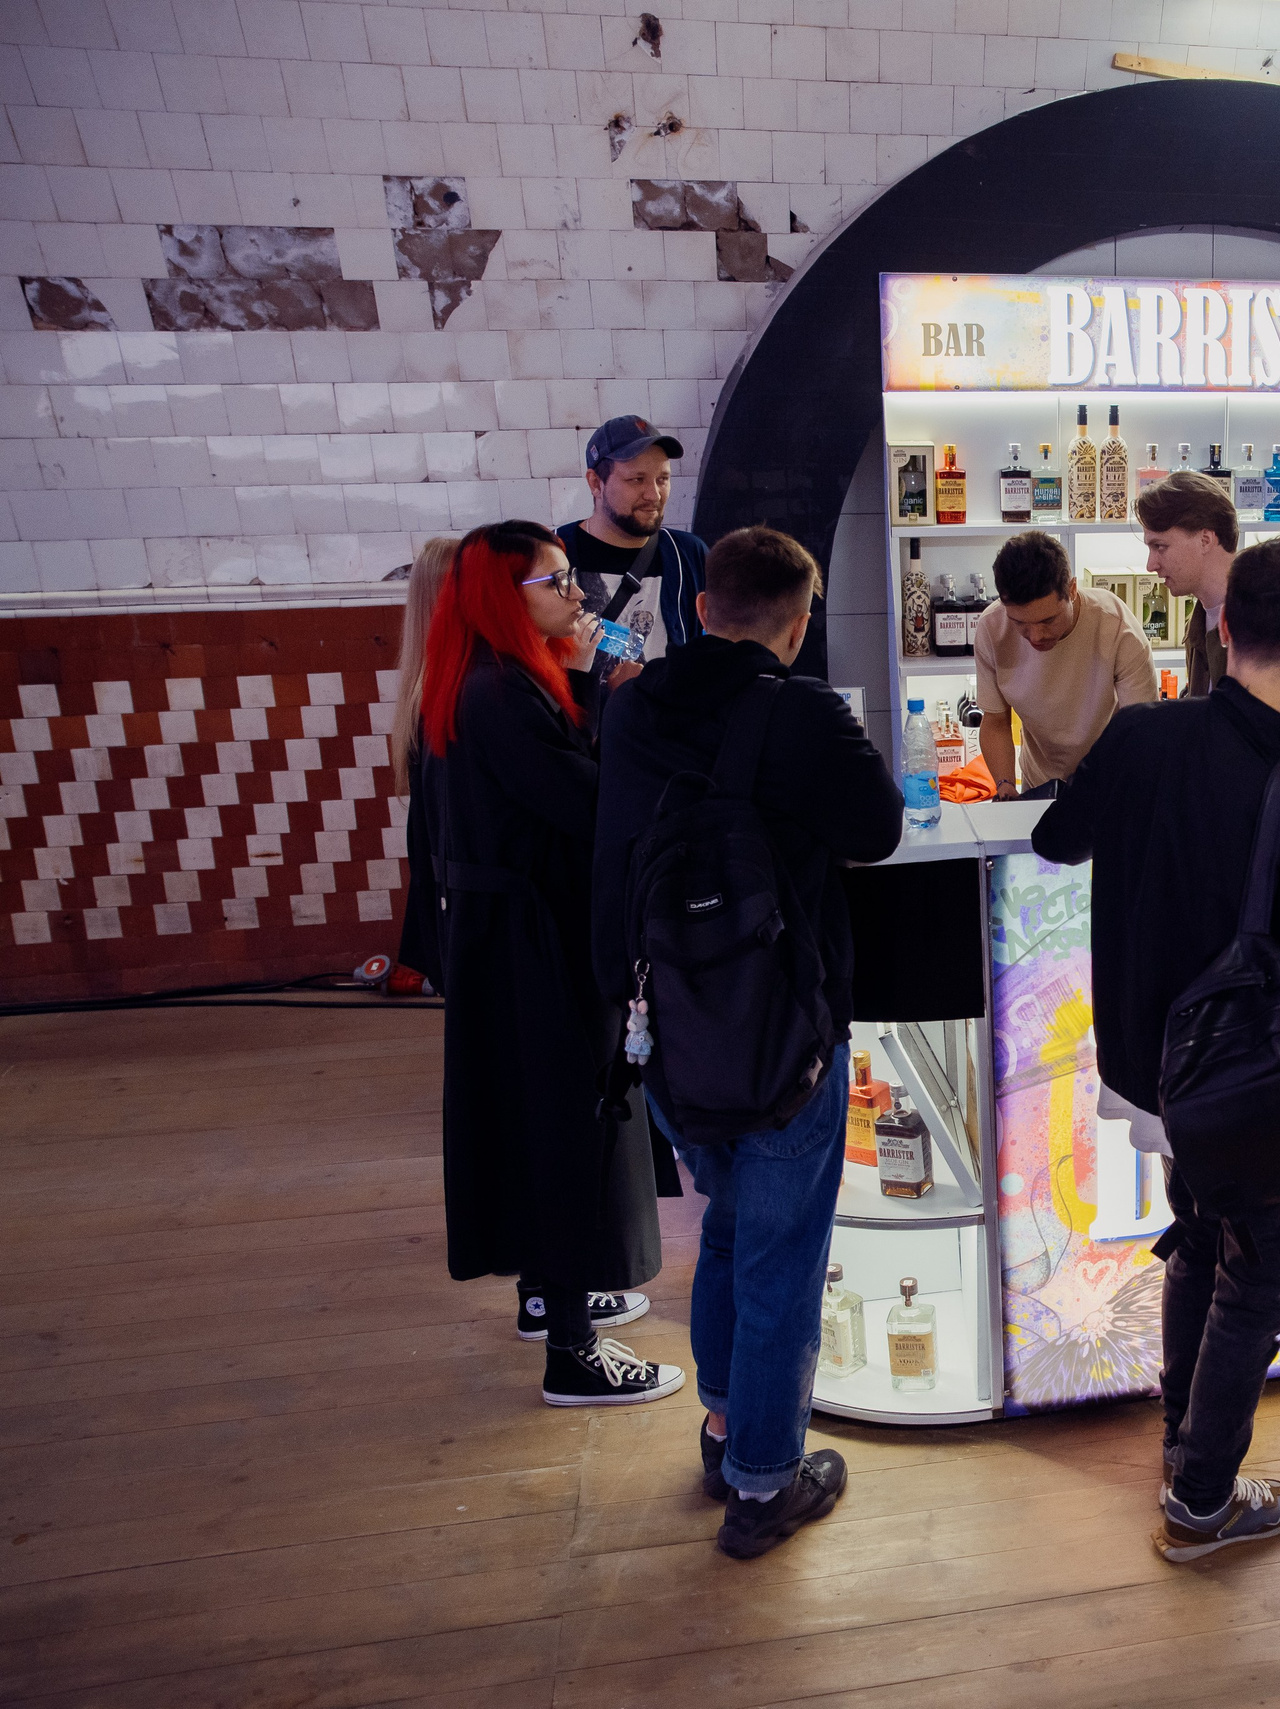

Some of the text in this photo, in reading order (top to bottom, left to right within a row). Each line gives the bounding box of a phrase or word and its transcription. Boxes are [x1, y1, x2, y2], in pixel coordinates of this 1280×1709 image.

[921, 323, 985, 357] BAR
[939, 621, 965, 629] BARRISTER
[848, 1116, 871, 1129] RRISTER
[878, 1147, 915, 1160] BARRISTER
[895, 1343, 925, 1351] BARRISTER
